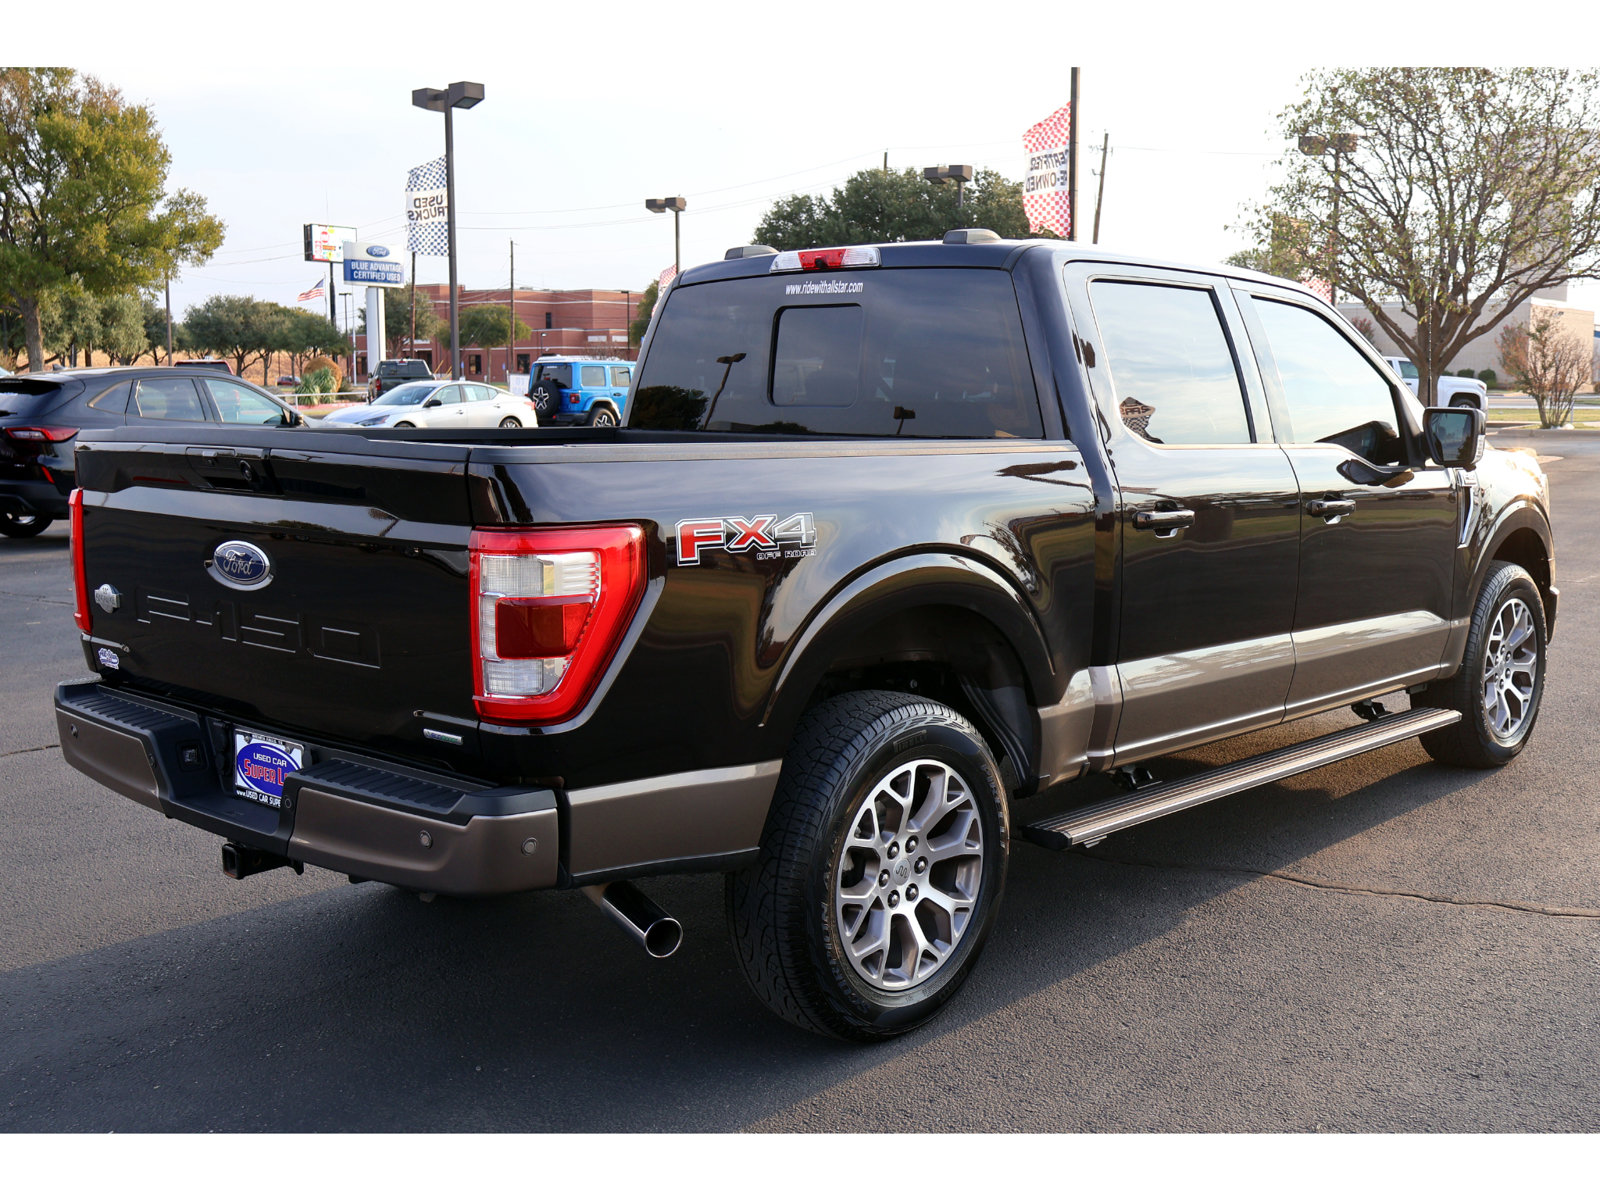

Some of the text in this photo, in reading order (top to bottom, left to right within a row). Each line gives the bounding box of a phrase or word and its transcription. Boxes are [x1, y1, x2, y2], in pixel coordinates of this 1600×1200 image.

[351, 261, 401, 272] BLUE ADVANTAGE
[353, 270, 401, 281] CERTIFIED USED
[785, 280, 864, 295] www.ridewithallstar.com
[675, 512, 818, 567] FX4
[757, 549, 817, 560] OFF ROAD
[223, 549, 253, 576] Ford
[253, 752, 287, 767] USED CAR
[277, 767, 288, 787] L
[258, 793, 269, 804] CAR
